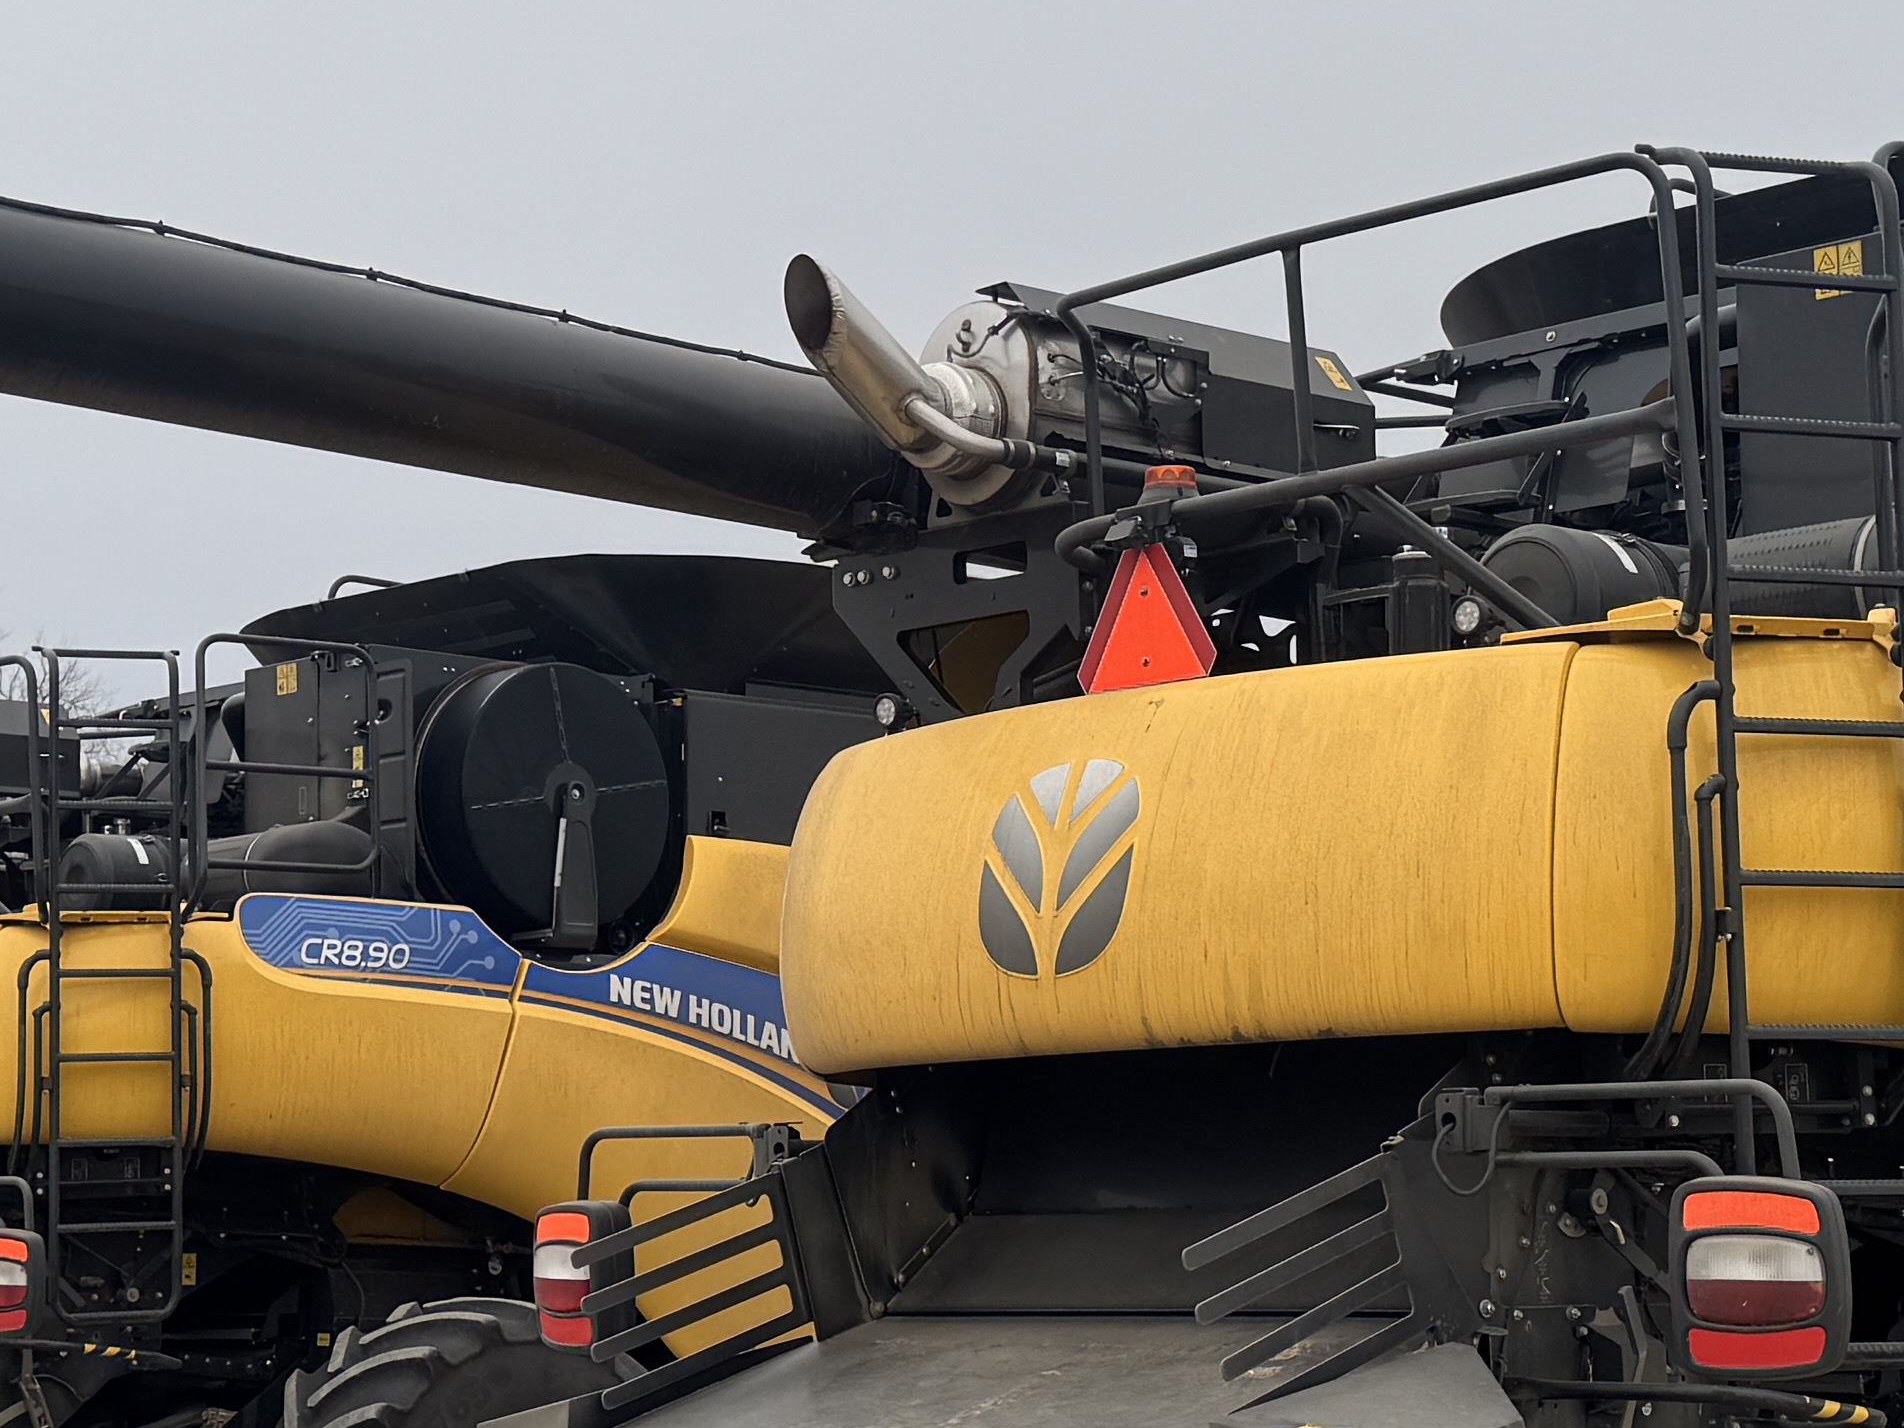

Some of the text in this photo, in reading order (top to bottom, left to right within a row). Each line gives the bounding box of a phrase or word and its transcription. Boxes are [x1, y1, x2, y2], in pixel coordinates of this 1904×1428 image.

[300, 937, 410, 970] CR8.90
[609, 973, 801, 1064] NEW HOLLAN
